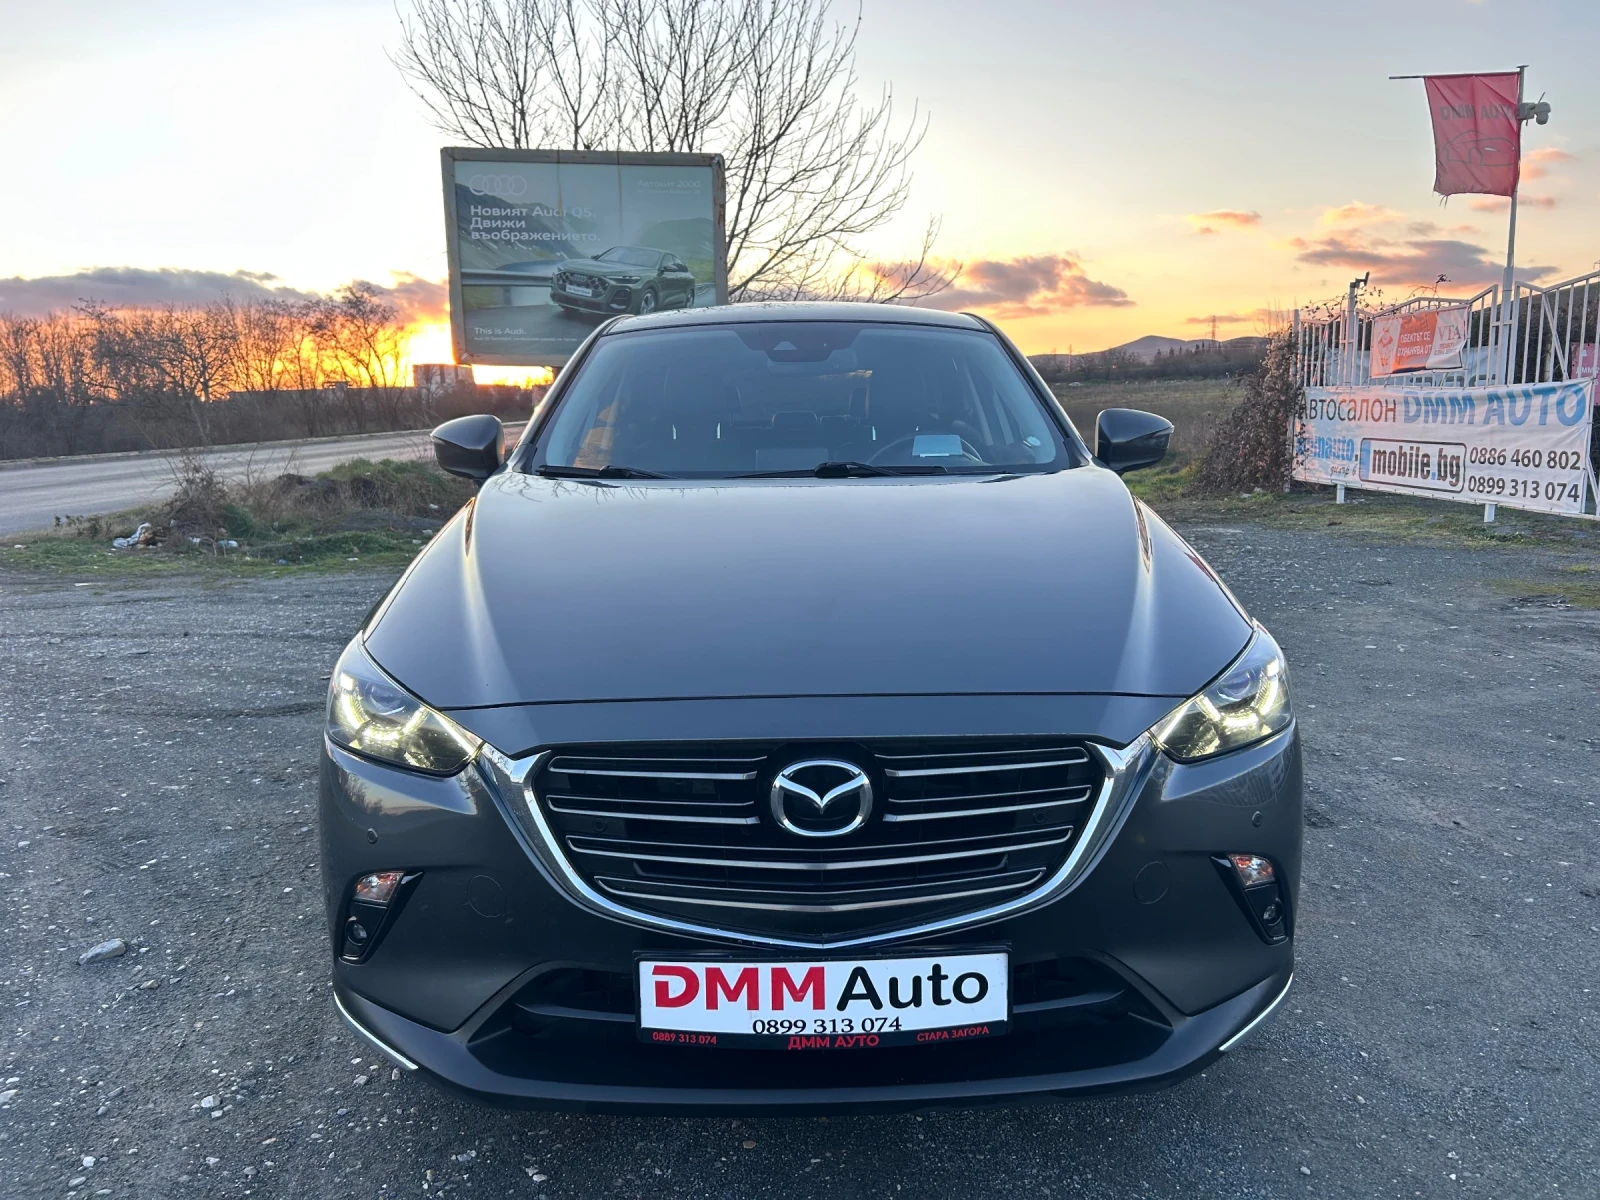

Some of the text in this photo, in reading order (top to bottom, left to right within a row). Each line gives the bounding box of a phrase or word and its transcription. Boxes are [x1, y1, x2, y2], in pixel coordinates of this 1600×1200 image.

[470, 205, 528, 217] Новият
[532, 205, 567, 217] Audi
[469, 217, 526, 230] Движи
[471, 230, 601, 242] въображението.
[474, 327, 527, 335] This is Audi.
[1424, 331, 1431, 341] СЕ
[1299, 390, 1397, 423] Автосалон
[1403, 384, 1587, 427] DMM AUTO
[1371, 445, 1461, 488] mobile.bg
[1469, 447, 1581, 470] 0886 460 802
[1468, 475, 1580, 503] 0899 313 074
[652, 963, 989, 1012] DMM Auto
[752, 1016, 902, 1034] 0899 313 074
[652, 1032, 717, 1045] 0889 313 074
[917, 1026, 989, 1042] СТАРА ЗАГОРА
[788, 1035, 880, 1050] ДММ АУТО
